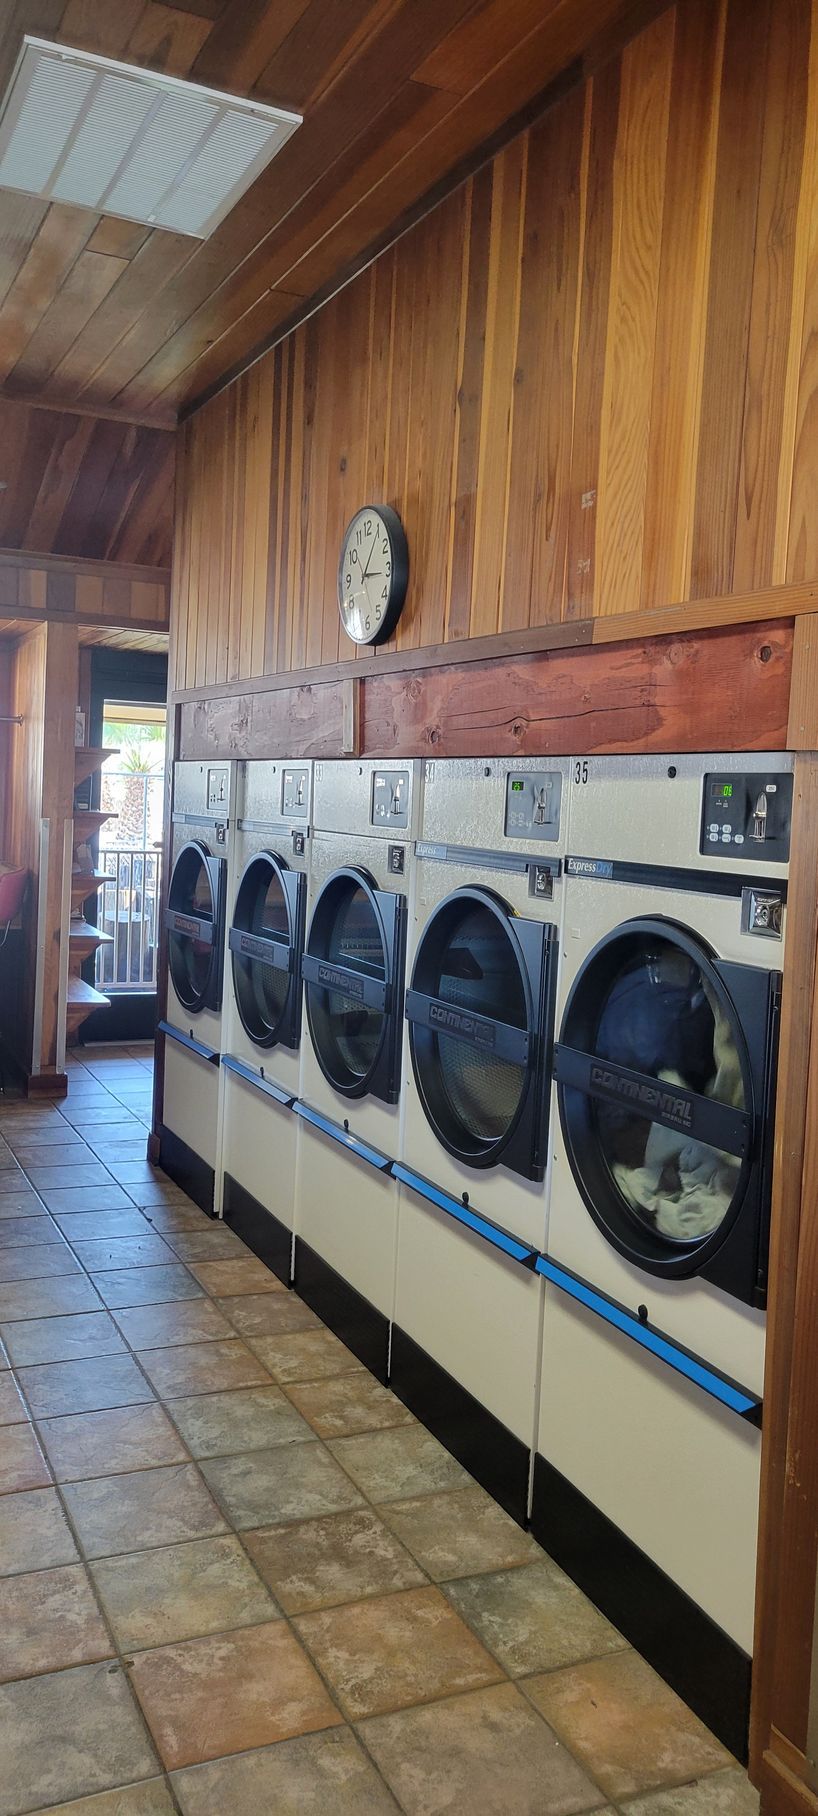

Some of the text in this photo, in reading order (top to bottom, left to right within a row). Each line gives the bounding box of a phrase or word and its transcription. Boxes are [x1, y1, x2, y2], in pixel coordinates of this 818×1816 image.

[363, 519, 372, 537] 12
[376, 522, 380, 539] 1
[356, 530, 362, 545] 11
[382, 538, 388, 555] 2
[349, 548, 358, 566] 10
[385, 561, 391, 578] 3
[346, 573, 352, 590] 9
[381, 585, 388, 600] 4
[349, 594, 354, 610] 8
[375, 604, 382, 621] 5
[365, 614, 370, 630] 6
[574, 760, 589, 785] 35
[591, 1067, 693, 1121] CONTINENTAL
